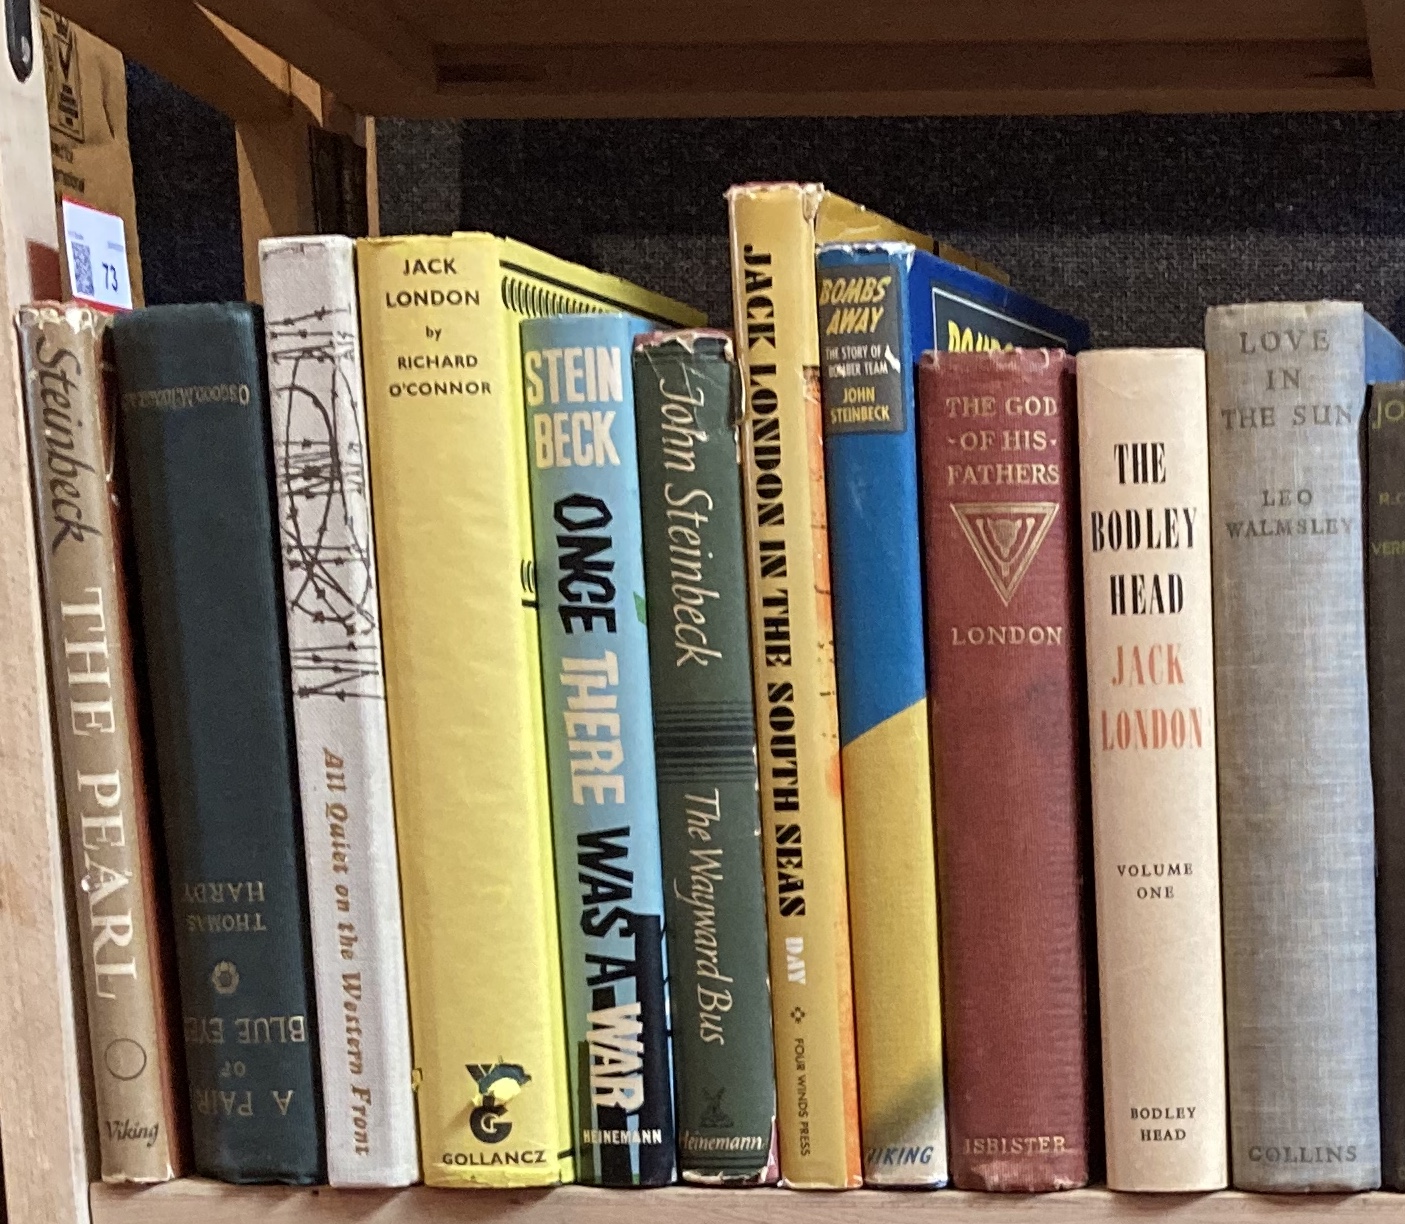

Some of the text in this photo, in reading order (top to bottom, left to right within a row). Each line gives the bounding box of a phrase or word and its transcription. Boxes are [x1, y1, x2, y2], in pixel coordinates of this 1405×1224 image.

[102, 262, 119, 292] 73
[402, 258, 457, 277] JACK
[386, 290, 480, 308] LONDON
[818, 275, 892, 307] BOMBS
[425, 324, 442, 341] by
[825, 306, 884, 336] AWAY
[825, 344, 882, 361] THE STORY OF
[1238, 329, 1331, 355] LOVE
[397, 354, 479, 371] RICHARD
[525, 346, 624, 407] STEIN
[864, 360, 889, 376] TEAM
[388, 381, 492, 397] O'CONNOR
[1266, 368, 1301, 391] IN
[842, 386, 876, 404] JOHN
[945, 396, 1058, 419] THE GOD
[830, 404, 891, 425] STEINBECK
[1220, 403, 1353, 432] THE SUN
[35, 336, 104, 555] Steinbeck
[534, 411, 622, 470] BECK
[960, 431, 1048, 453] OF HIS
[946, 463, 1061, 488] FATHERS
[1113, 442, 1167, 485] THE
[1261, 488, 1314, 508] LEO
[660, 377, 723, 668] John Steinbeck
[1091, 507, 1198, 553] BODLEY
[553, 492, 617, 635] ONCE
[1110, 573, 1185, 615] HEAD
[743, 244, 808, 986] JACK LONDON IN THE SOUTH SEAS DAY
[951, 626, 1064, 648] LONDON
[1111, 643, 1185, 687] JACK
[560, 652, 627, 806] THERE
[1101, 706, 1203, 752] LONDON
[60, 586, 136, 999] THE PEARL
[577, 825, 635, 940] WAS
[1116, 862, 1195, 879] VOLUME
[1136, 885, 1176, 900] ONE
[674, 788, 734, 1047] The Wayward Bus
[323, 747, 372, 1157] All Quiet on the Western Front
[586, 1001, 646, 1115] WAR
[794, 1037, 813, 1157] FOUR WINDS PRESS
[1130, 1106, 1197, 1122] BODLEY
[106, 1118, 159, 1147] Viking
[583, 1128, 663, 1145] HEINEMANN
[1139, 1128, 1188, 1143] HEAD
[442, 1150, 547, 1167] GOLLANCZ
